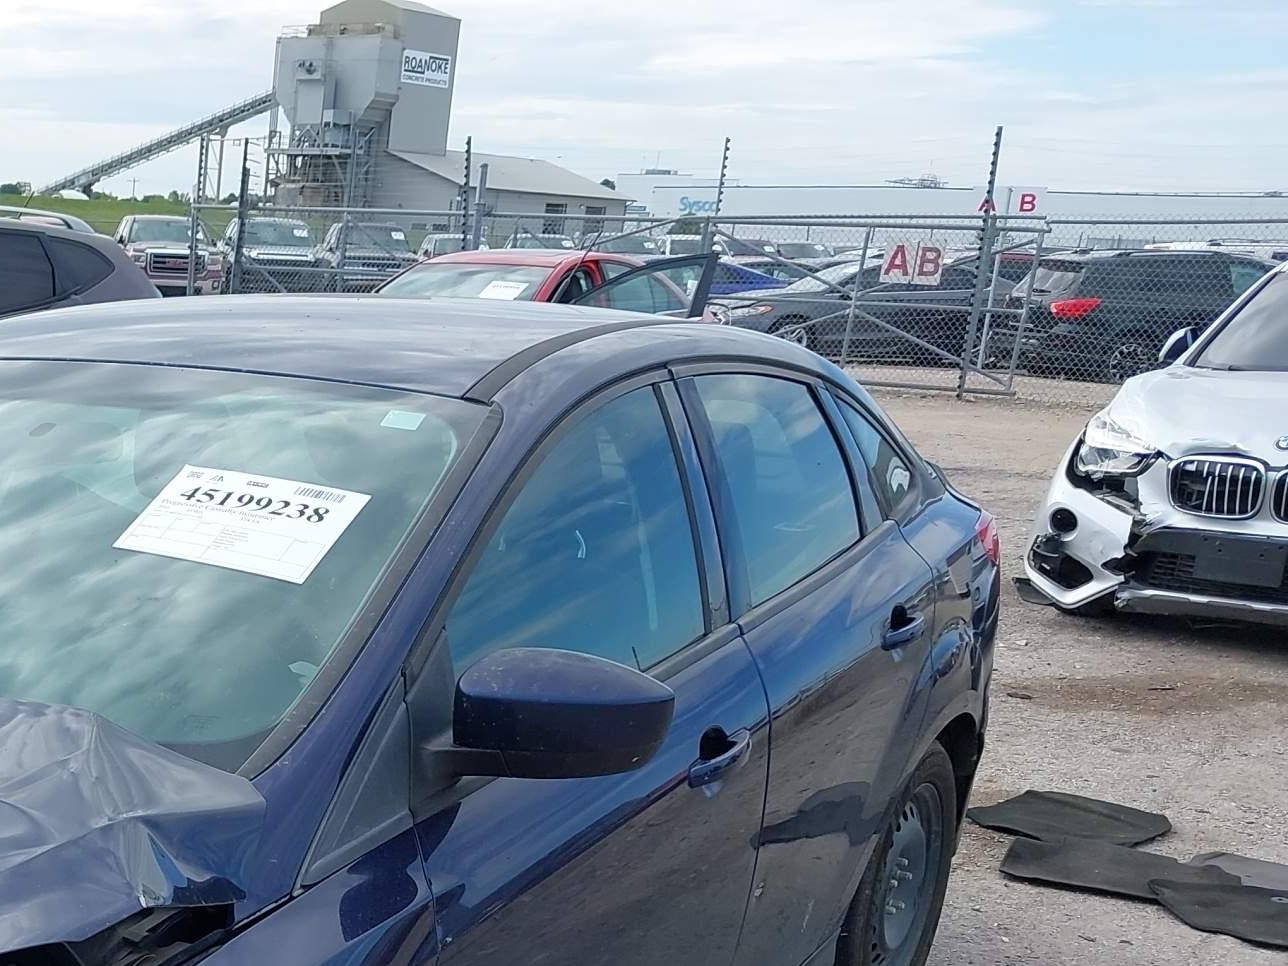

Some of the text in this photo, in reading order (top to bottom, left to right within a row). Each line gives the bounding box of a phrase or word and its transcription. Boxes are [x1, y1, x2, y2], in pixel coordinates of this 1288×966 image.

[404, 55, 449, 75] ROANOKE
[978, 193, 1037, 212] A B
[883, 244, 942, 277] A B
[180, 486, 330, 524] 45199238
